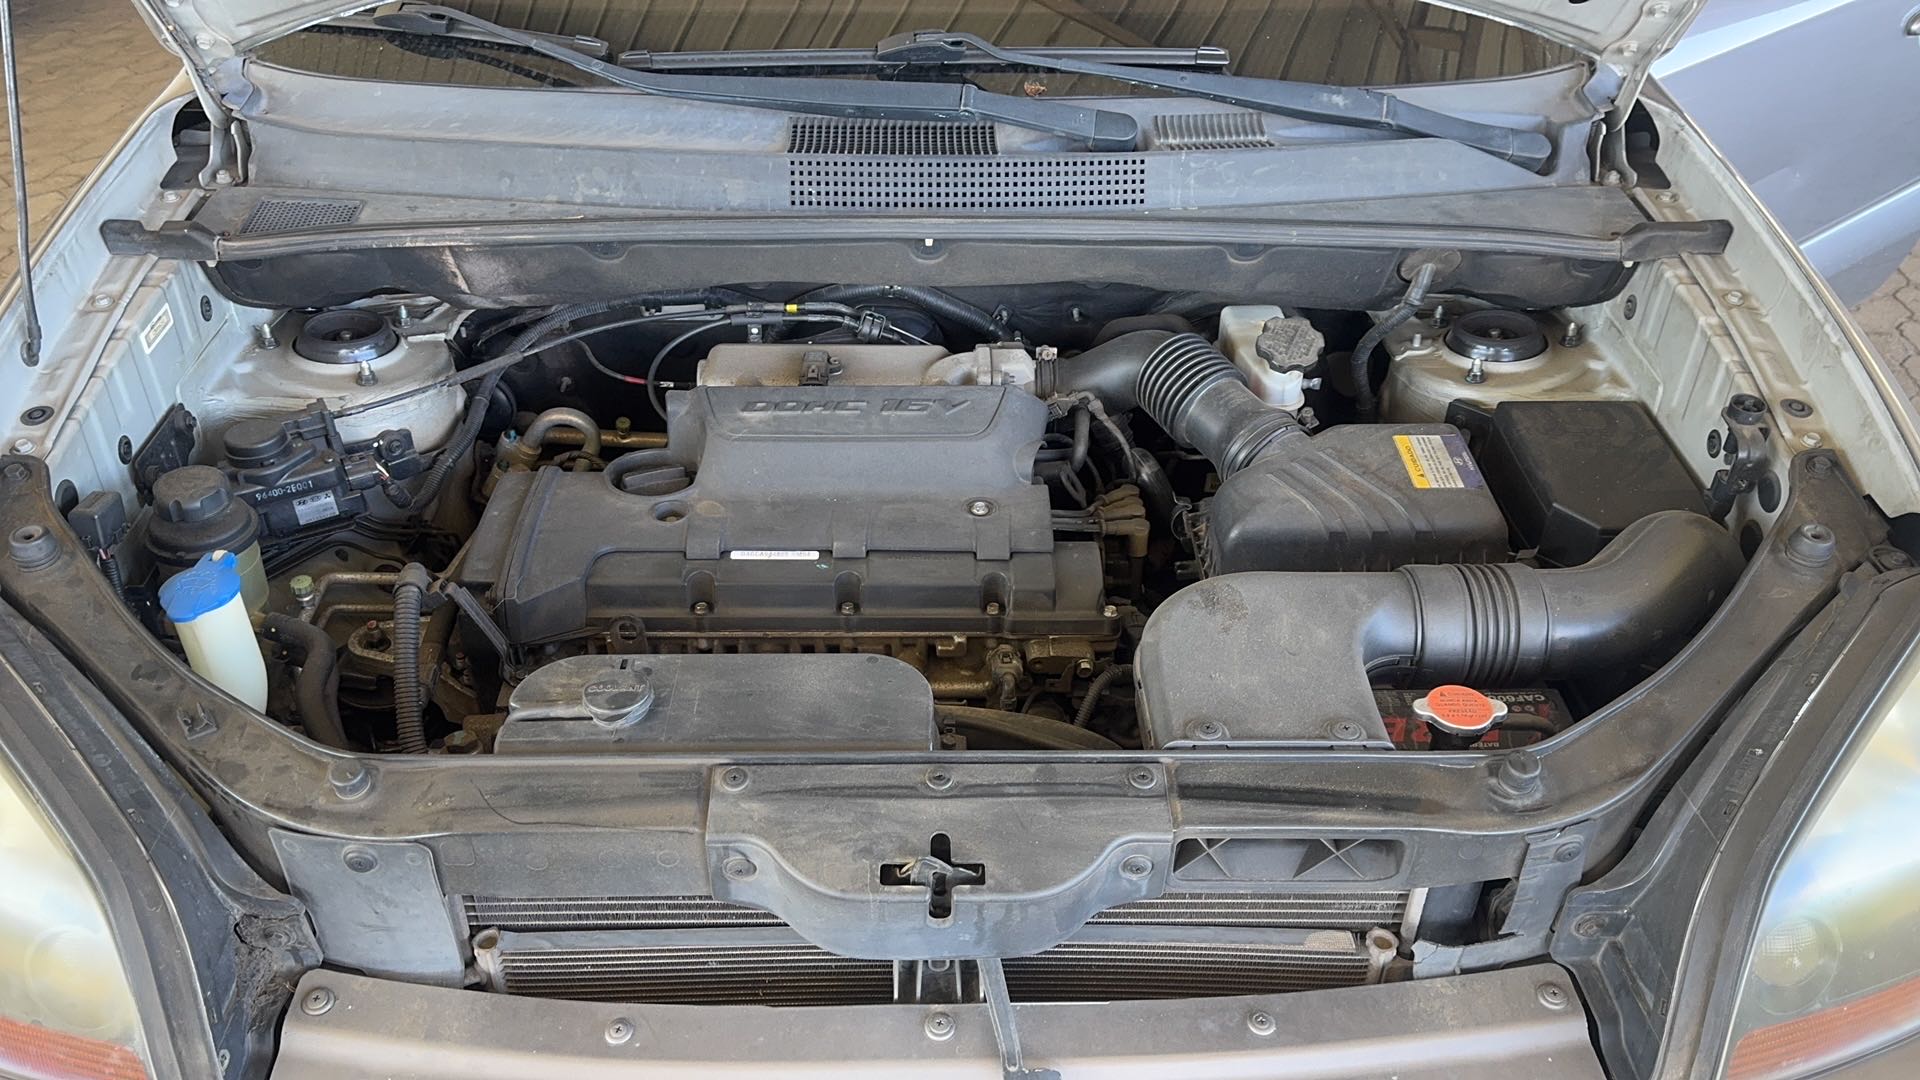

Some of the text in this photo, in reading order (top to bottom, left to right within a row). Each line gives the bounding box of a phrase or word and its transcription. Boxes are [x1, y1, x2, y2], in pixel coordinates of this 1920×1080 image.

[739, 398, 972, 416] DOHC 16V
[1404, 445, 1421, 473] CUIDADO
[255, 480, 313, 501] 96400-2E001
[588, 684, 645, 693] COOLANT
